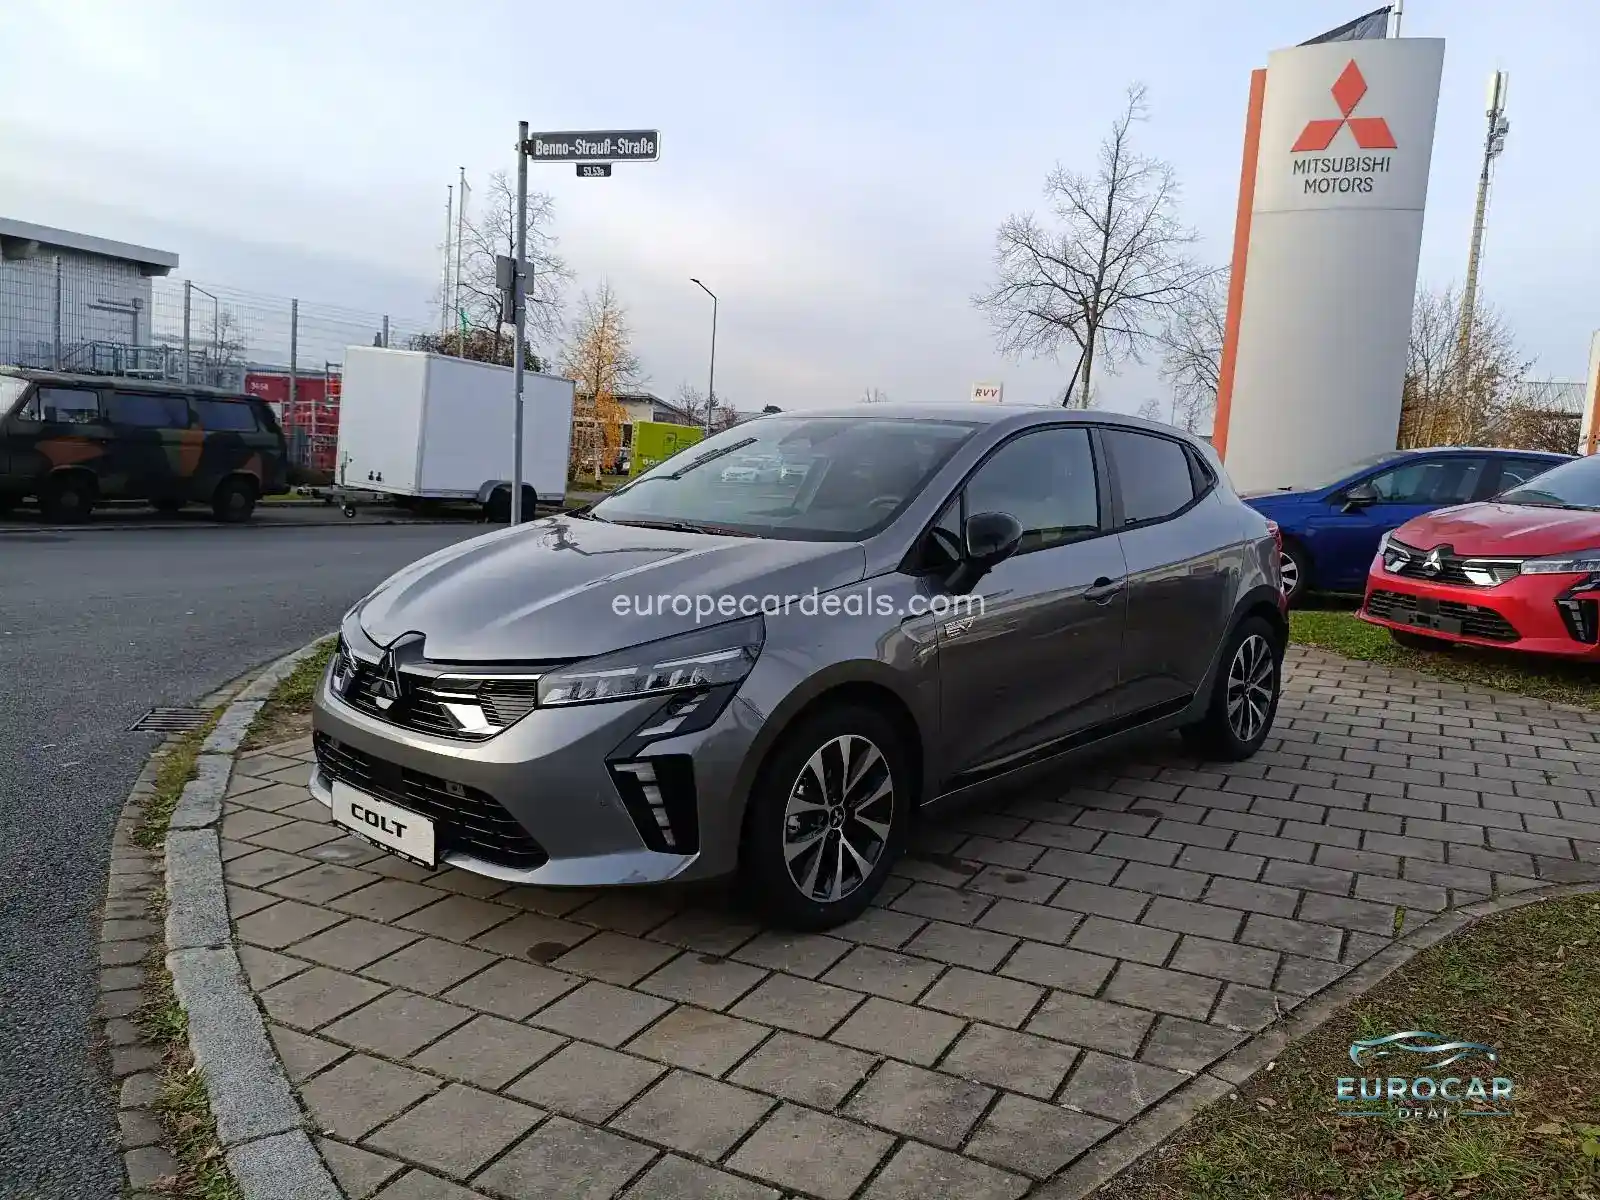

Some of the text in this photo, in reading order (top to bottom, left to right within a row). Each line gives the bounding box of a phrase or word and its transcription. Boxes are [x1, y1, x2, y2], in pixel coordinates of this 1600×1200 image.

[535, 137, 654, 156] Benno-Strauß-Straße
[1293, 156, 1391, 175] MITSUBISHI
[1303, 176, 1374, 194] MOTORS
[975, 388, 998, 397] RVV
[351, 803, 408, 838] COLT
